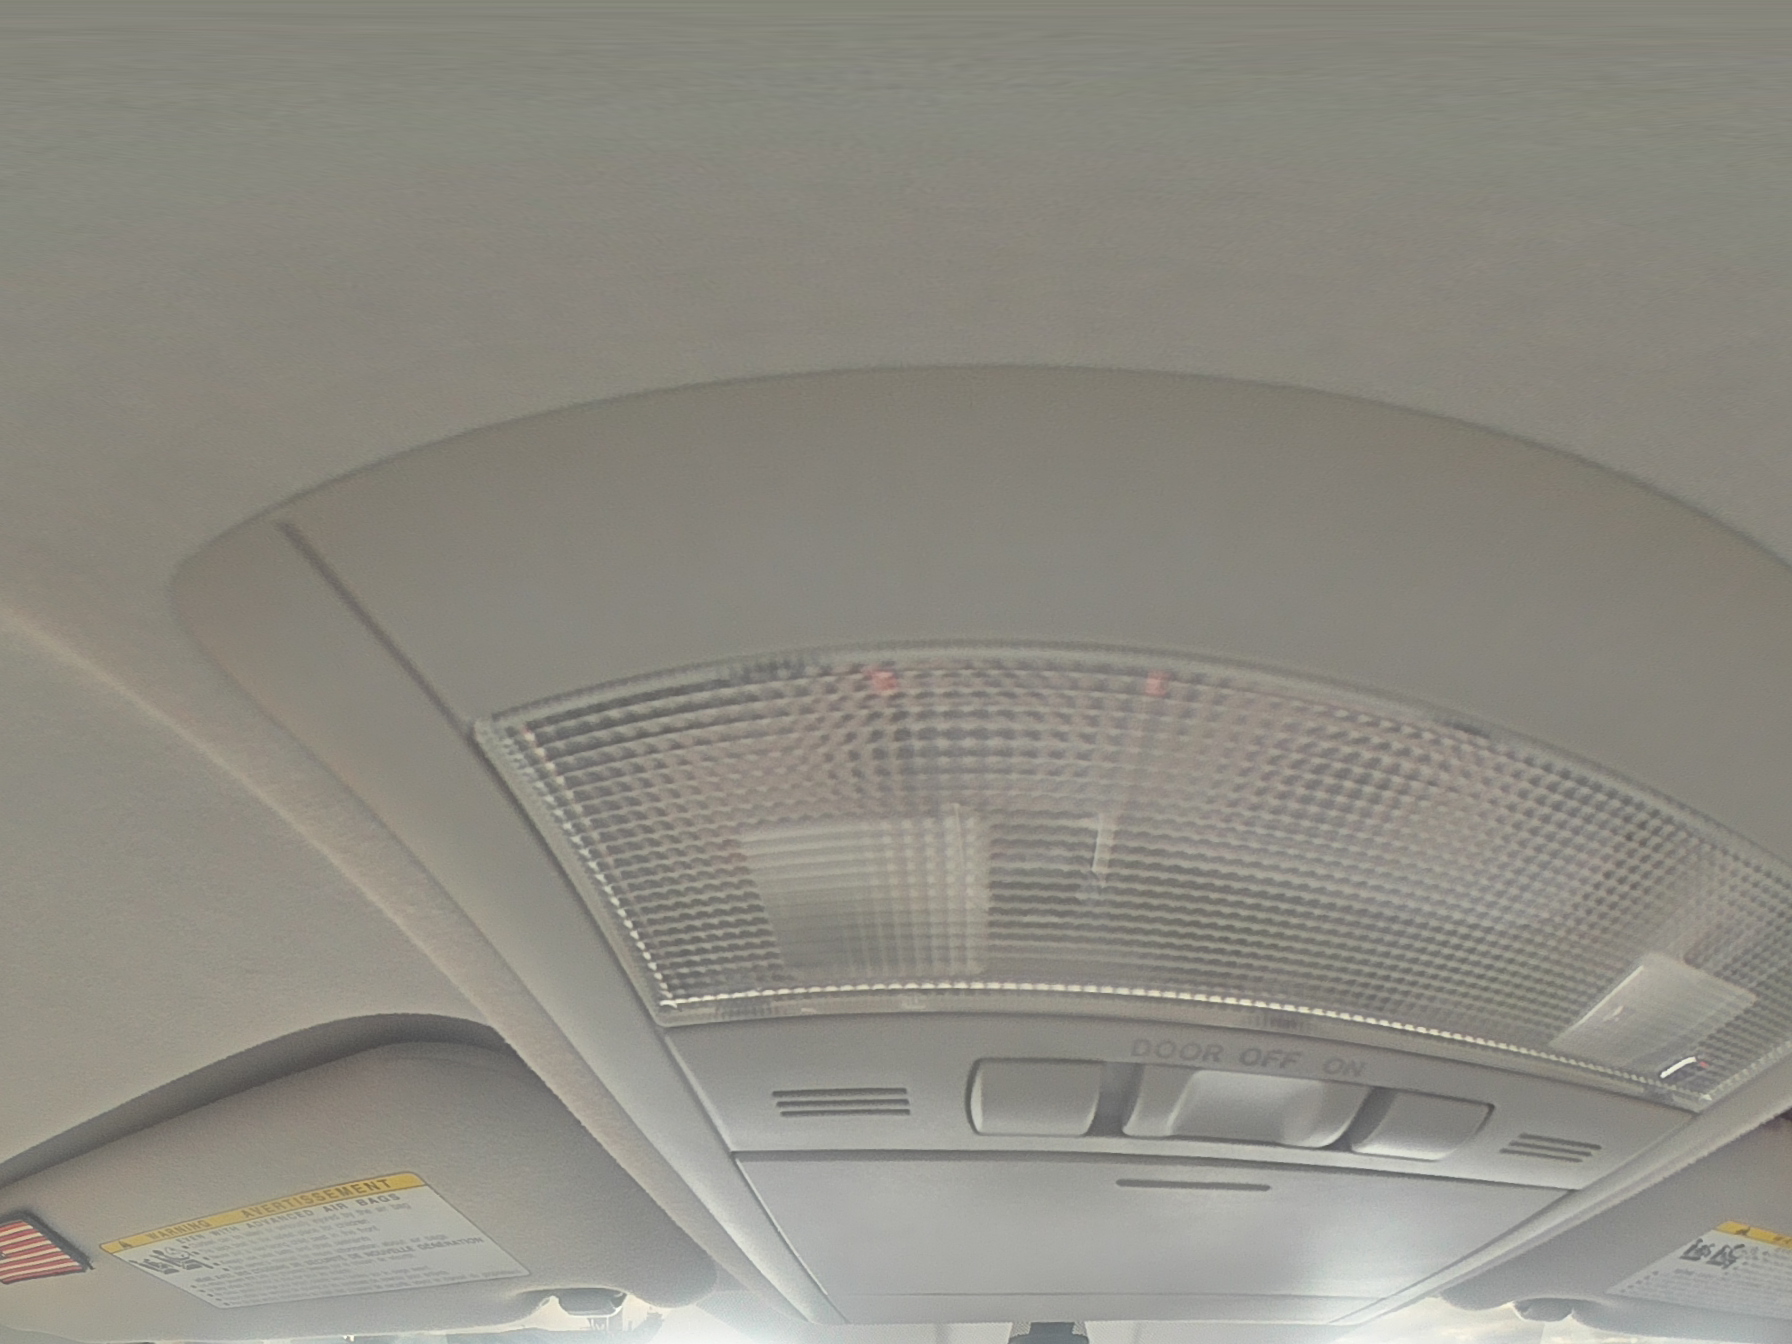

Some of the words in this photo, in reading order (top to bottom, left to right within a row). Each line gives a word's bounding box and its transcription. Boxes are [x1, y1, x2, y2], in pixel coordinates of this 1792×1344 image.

[1131, 1038, 1224, 1063] DOOR
[1239, 1048, 1301, 1069] OFF
[1323, 1056, 1366, 1077] ON
[175, 1233, 206, 1244] EVEN
[210, 1225, 240, 1237] WITH
[245, 1209, 314, 1229] ADVANCED
[323, 1202, 349, 1213] AIR
[355, 1193, 401, 1207] BAGS
[241, 1178, 392, 1219] AVERTISSEMENT
[146, 1219, 211, 1240] WARNING
